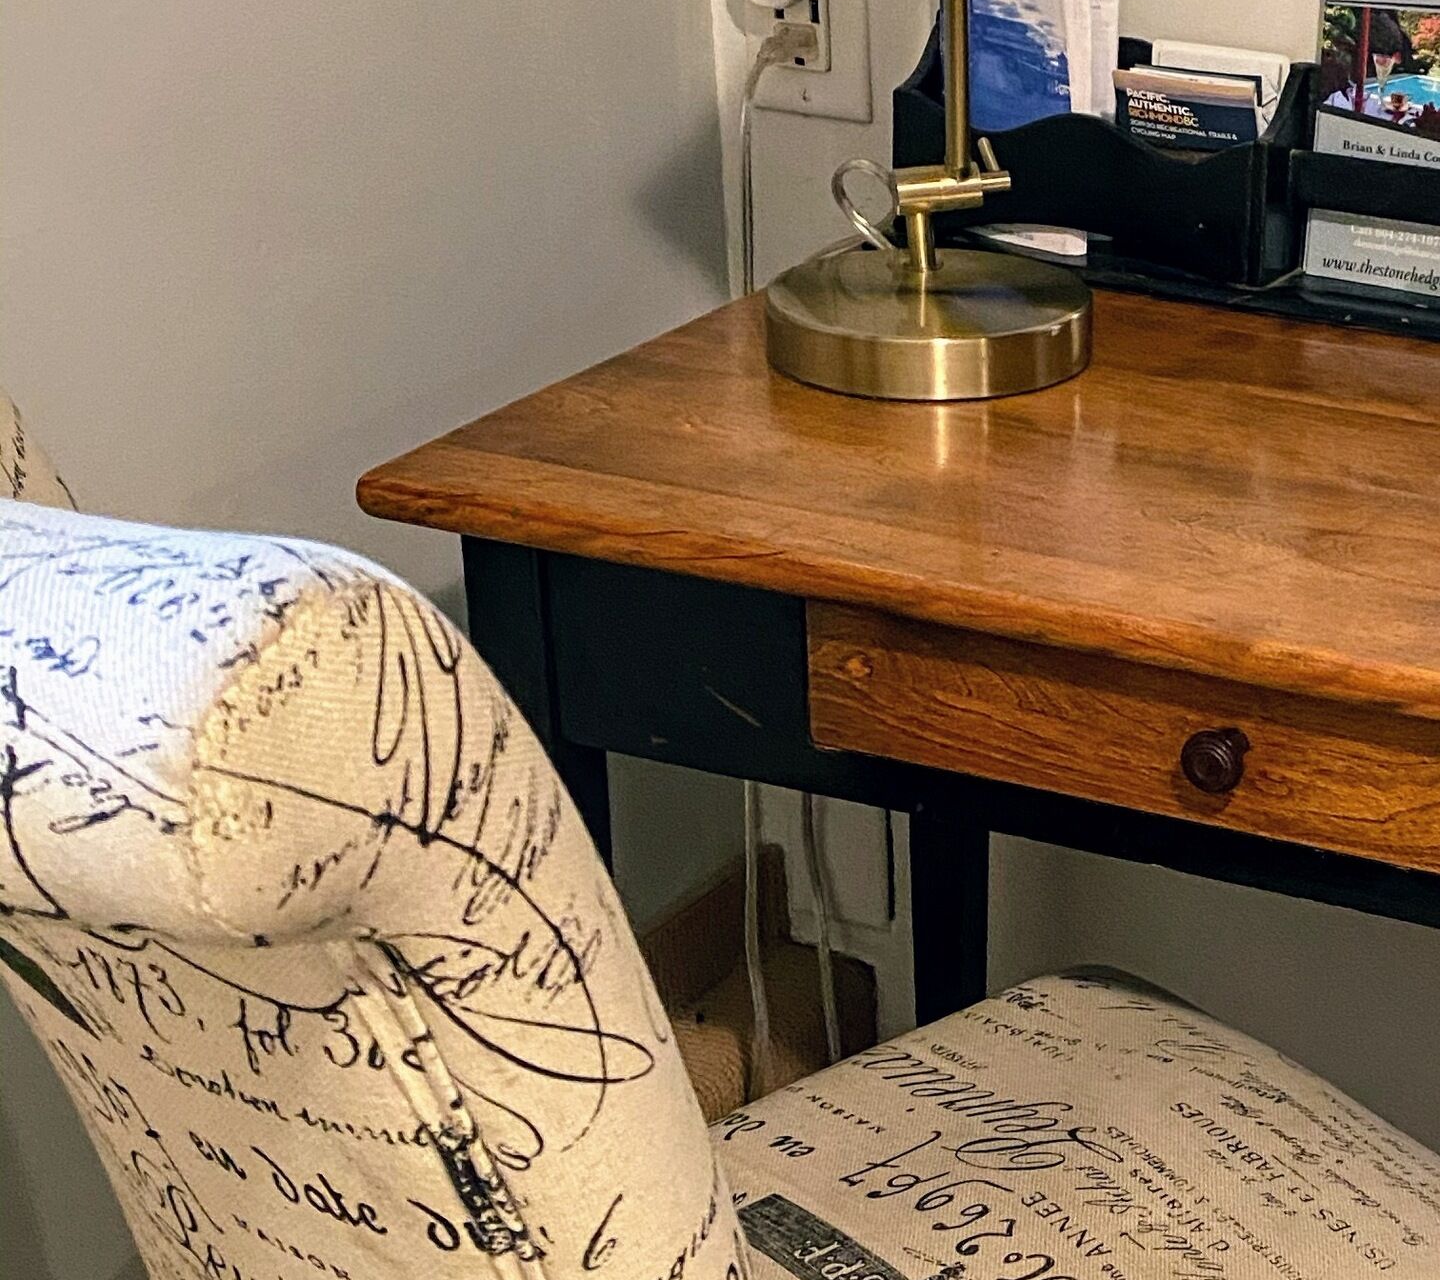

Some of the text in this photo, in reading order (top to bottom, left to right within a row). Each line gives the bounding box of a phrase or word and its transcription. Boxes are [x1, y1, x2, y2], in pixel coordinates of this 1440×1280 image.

[1342, 140, 1372, 155] Brian
[1375, 145, 1385, 155] &
[1389, 147, 1420, 160] Linda
[1170, 1103, 1283, 1182] FABRIQUES
[251, 1145, 389, 1236] date
[839, 1131, 1016, 1268] 26967
[1021, 1192, 1112, 1257] ANNEE
